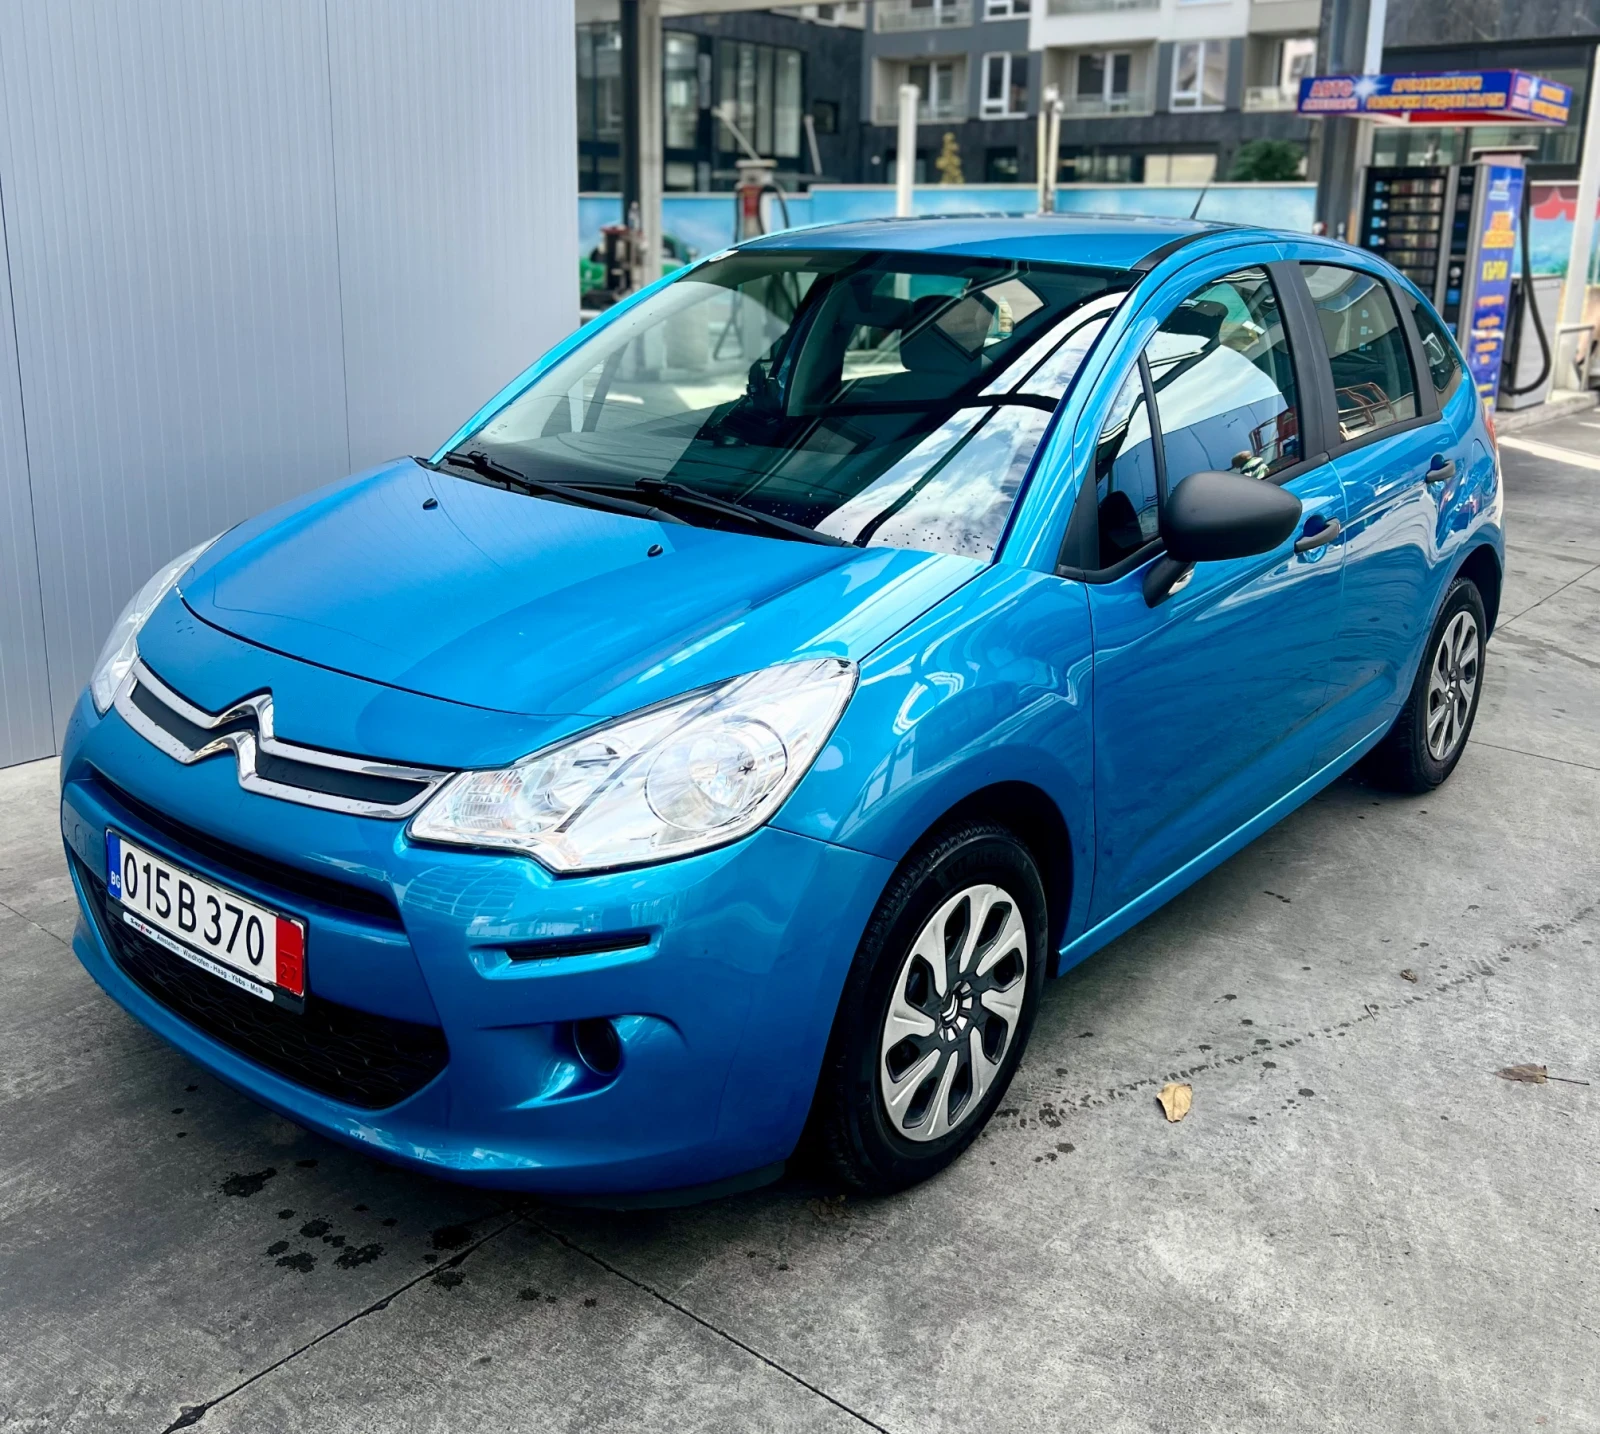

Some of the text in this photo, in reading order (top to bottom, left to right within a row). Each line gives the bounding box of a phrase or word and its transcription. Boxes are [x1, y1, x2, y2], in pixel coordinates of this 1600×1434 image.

[1309, 79, 1353, 97] АВТО
[111, 871, 121, 888] BG
[183, 947, 209, 969] Waidhofen
[213, 964, 227, 979] Haag
[231, 974, 246, 987] Ybbs
[250, 982, 264, 995] Melk
